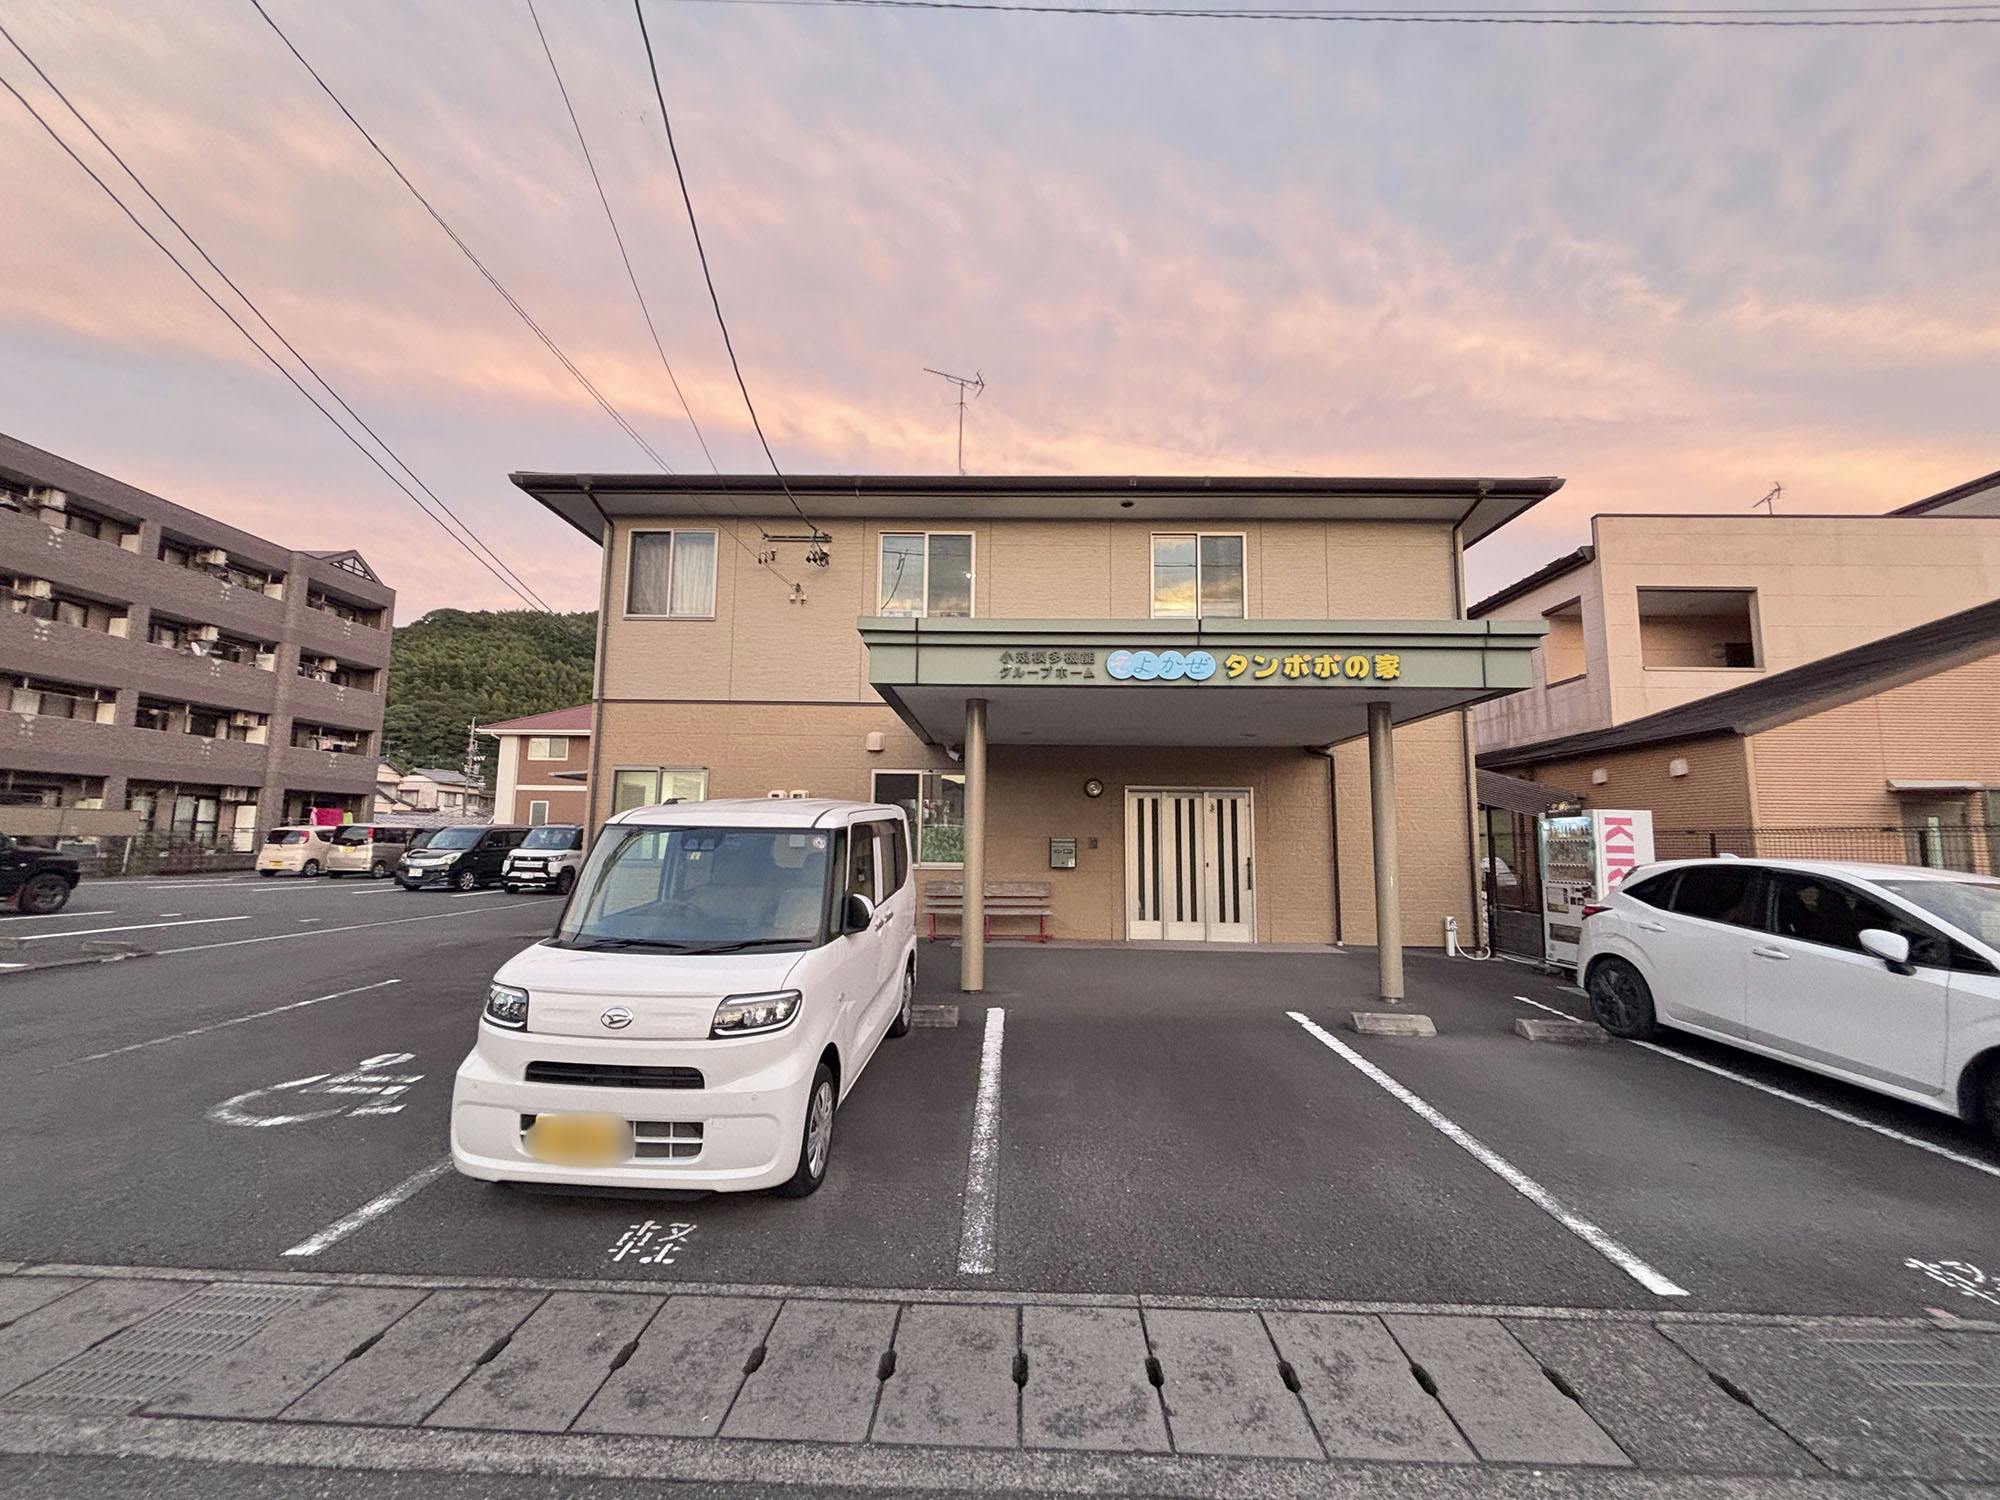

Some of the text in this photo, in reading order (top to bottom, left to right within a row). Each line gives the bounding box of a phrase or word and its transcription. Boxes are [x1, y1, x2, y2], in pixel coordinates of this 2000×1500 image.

[1000, 666, 1095, 679] グループホーム
[1224, 653, 1401, 680] タンポポの家
